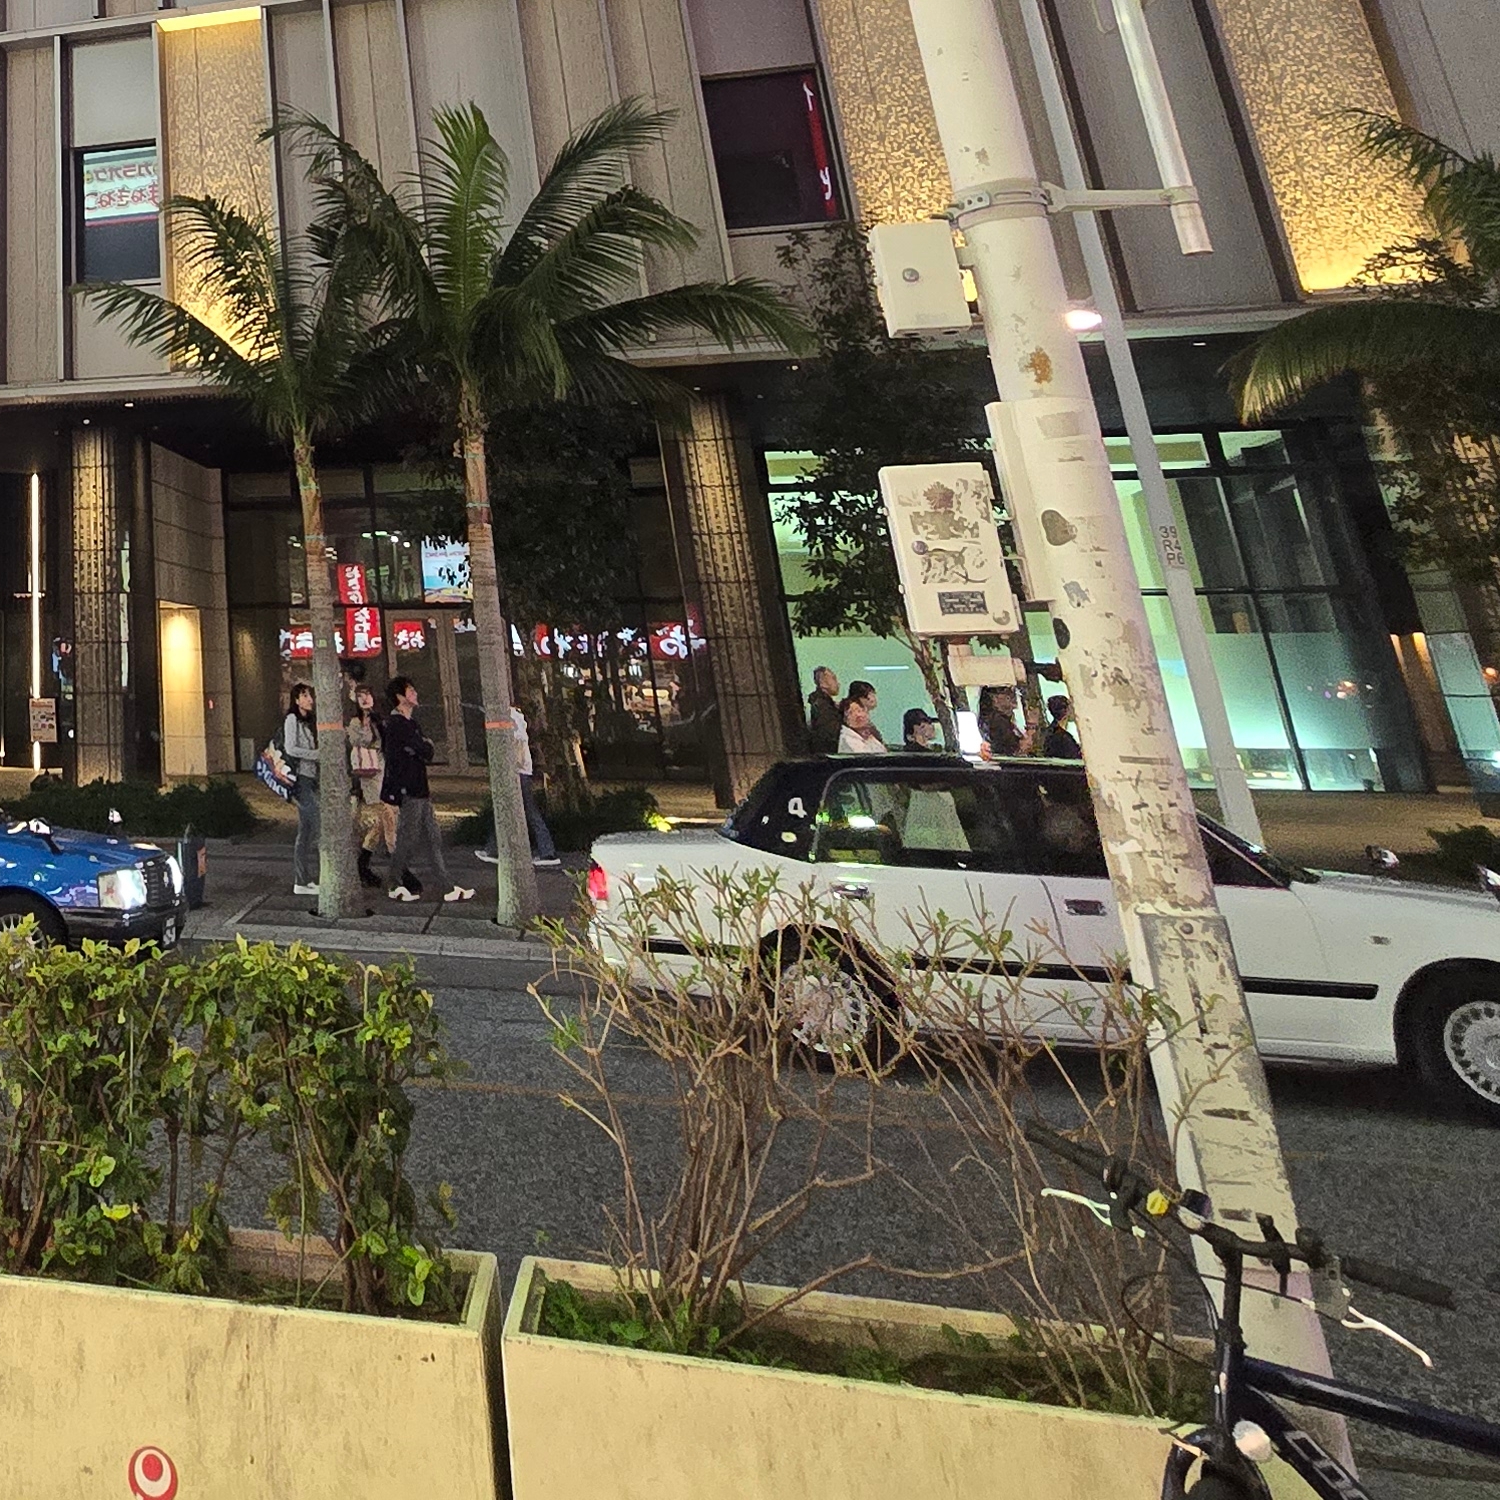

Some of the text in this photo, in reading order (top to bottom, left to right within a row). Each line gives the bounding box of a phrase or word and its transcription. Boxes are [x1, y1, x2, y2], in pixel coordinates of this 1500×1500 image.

[1159, 526, 1177, 538] 39
[1163, 540, 1181, 551] R4
[1167, 552, 1185, 565] P6
